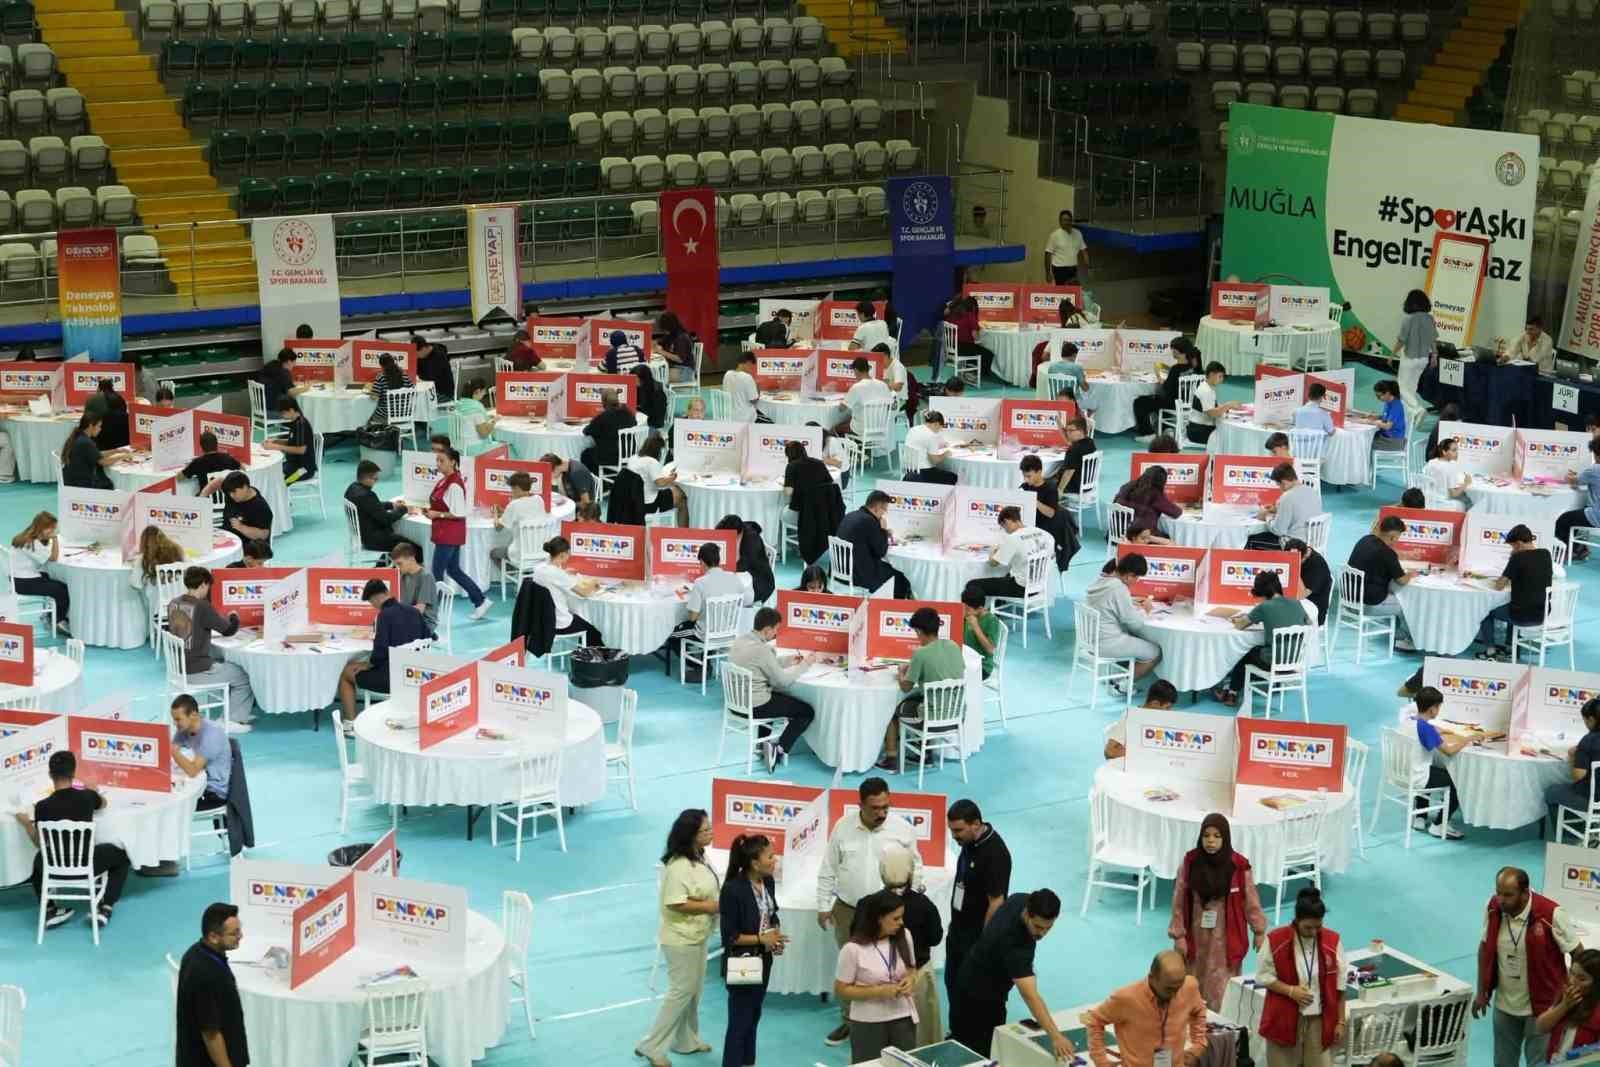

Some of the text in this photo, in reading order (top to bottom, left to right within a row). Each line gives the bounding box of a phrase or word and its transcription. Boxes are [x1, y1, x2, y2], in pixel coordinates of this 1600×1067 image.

[1230, 185, 1317, 218] MUĞLA
[66, 291, 114, 300] Deneyap
[1575, 278, 1594, 324] MUĞLA
[1563, 400, 1568, 408] 2
[687, 433, 732, 444] DENEYAP
[1530, 444, 1577, 453] DENEYAP
[72, 504, 119, 514] DENEYAP
[150, 510, 198, 520] DENEYAP
[576, 538, 629, 548] DENEYAP
[794, 608, 849, 622] DENEYAP
[1442, 678, 1506, 690] DENEYAP
[431, 686, 467, 710] DENEYAP
[495, 684, 550, 700] DENEYAP
[1145, 729, 1212, 745] DENEYAP
[88, 739, 152, 753] DENEYAP
[1258, 740, 1326, 754] DENEYAP
[4, 743, 52, 768] DENEYAP
[376, 899, 446, 920] DENEYAP
